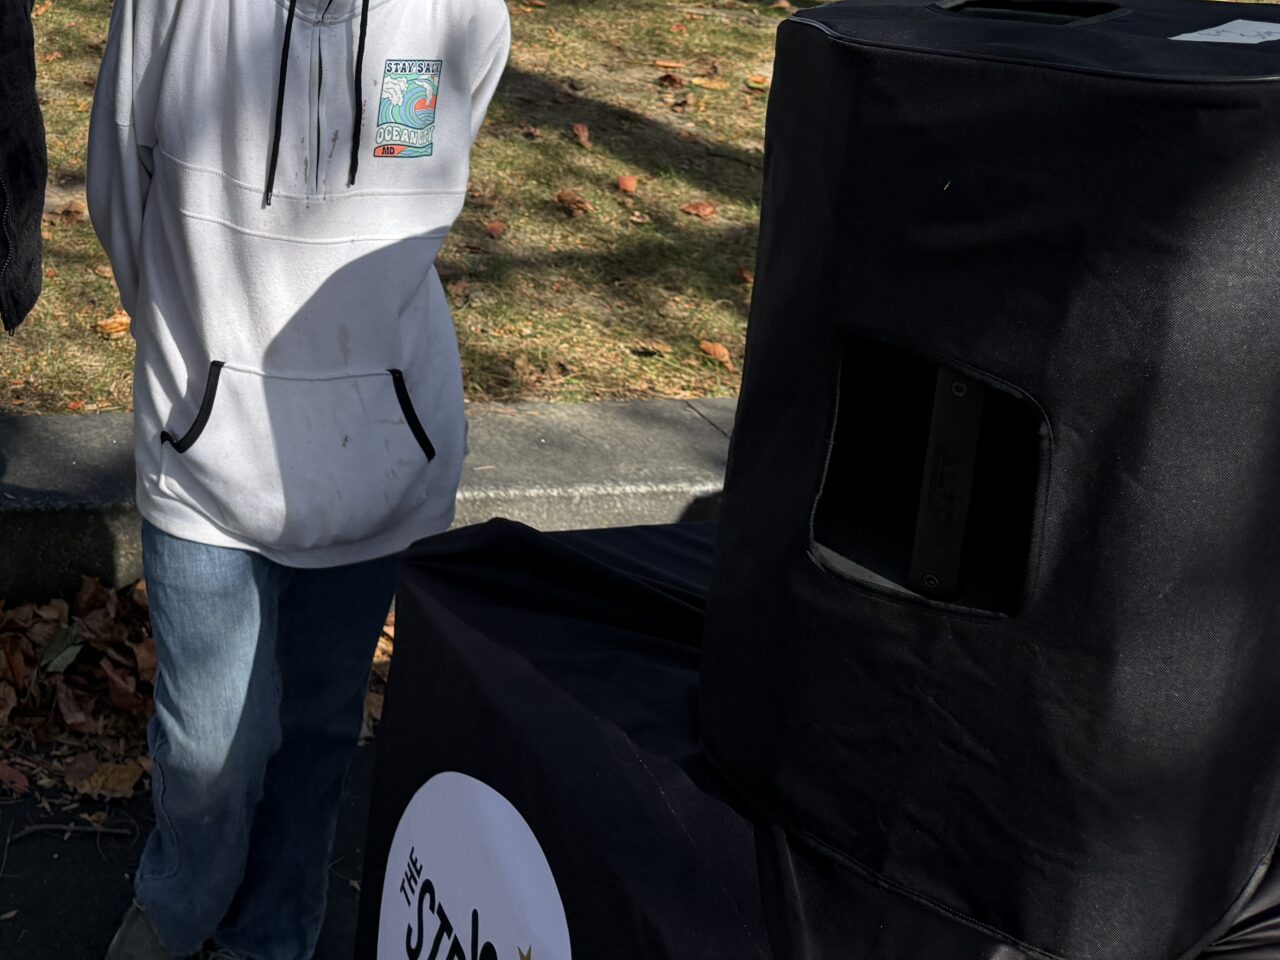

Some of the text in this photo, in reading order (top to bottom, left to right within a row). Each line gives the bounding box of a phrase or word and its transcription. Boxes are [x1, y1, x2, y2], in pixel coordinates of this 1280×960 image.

[386, 62, 414, 73] STAY
[376, 126, 417, 145] OCEAN
[381, 146, 395, 155] MD
[399, 845, 423, 908] THE
